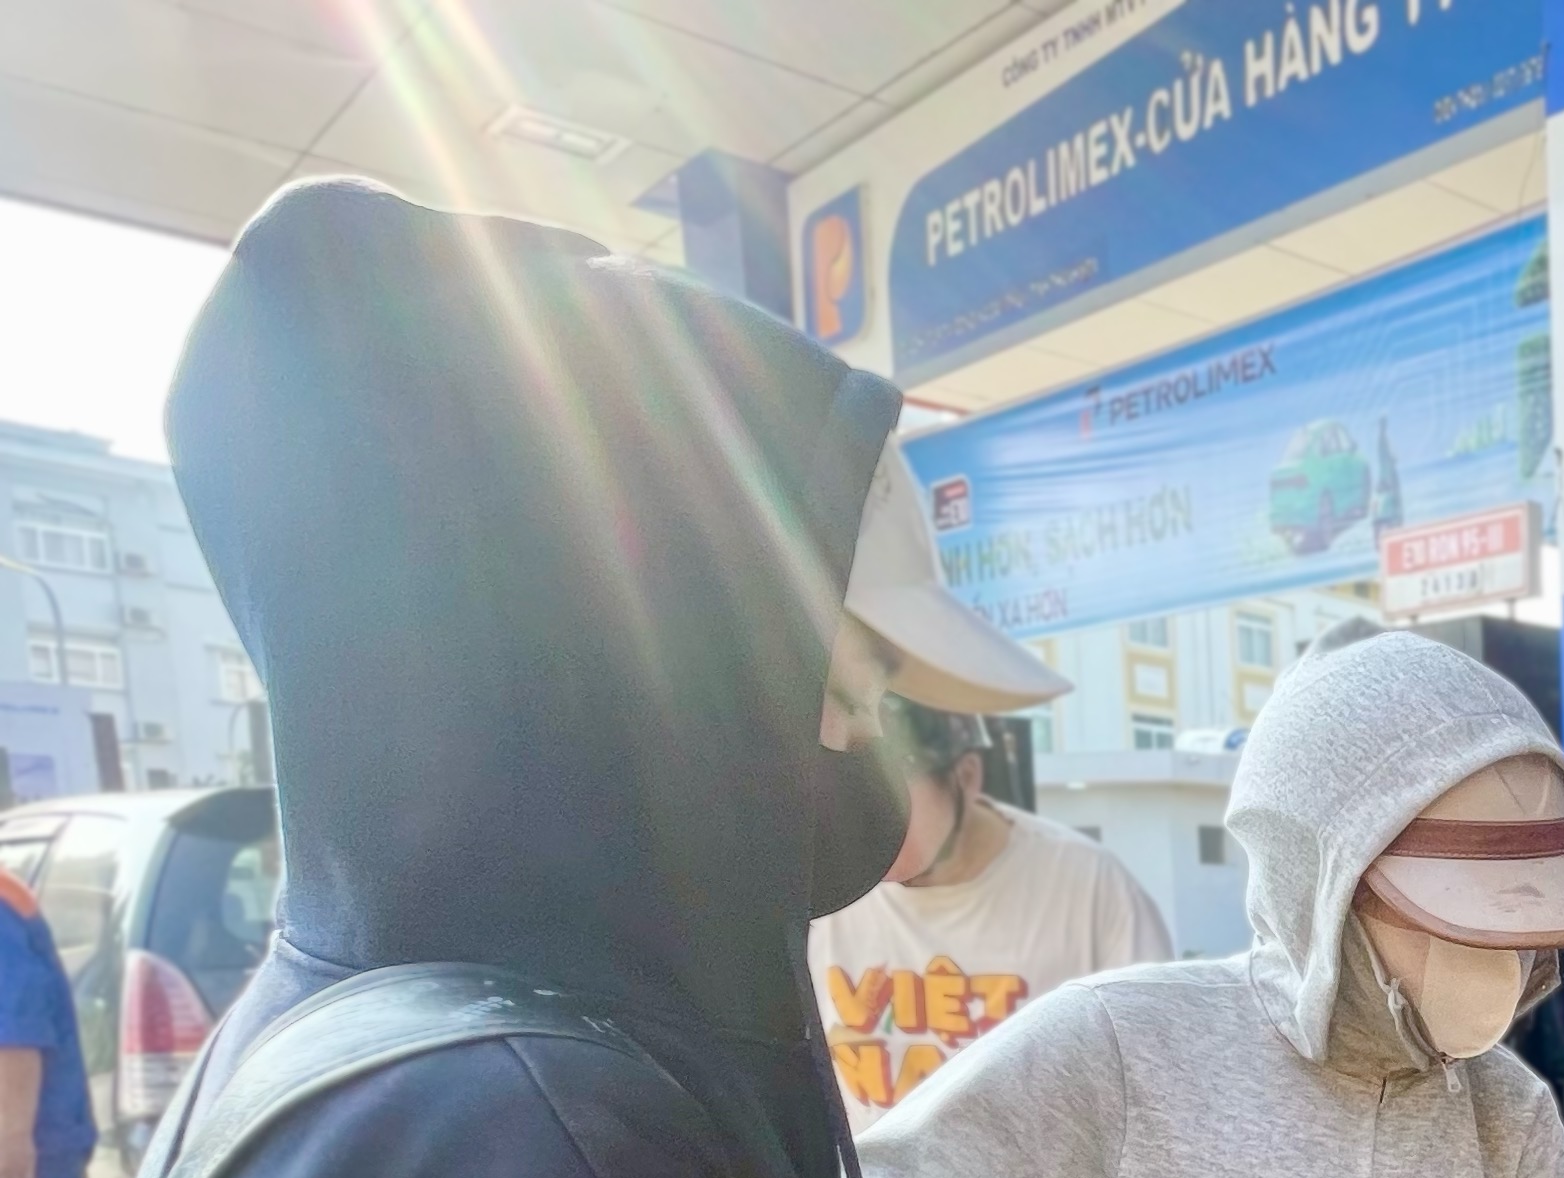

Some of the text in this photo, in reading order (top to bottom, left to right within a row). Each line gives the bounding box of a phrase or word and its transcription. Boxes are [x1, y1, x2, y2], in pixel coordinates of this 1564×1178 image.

[1041, 36, 1059, 62] TY
[1245, 0, 1379, 108] HÀNG
[1108, 344, 1277, 426] PETROLIMEX
[828, 956, 1028, 1049] VIỆT
[830, 1042, 951, 1108] NA
